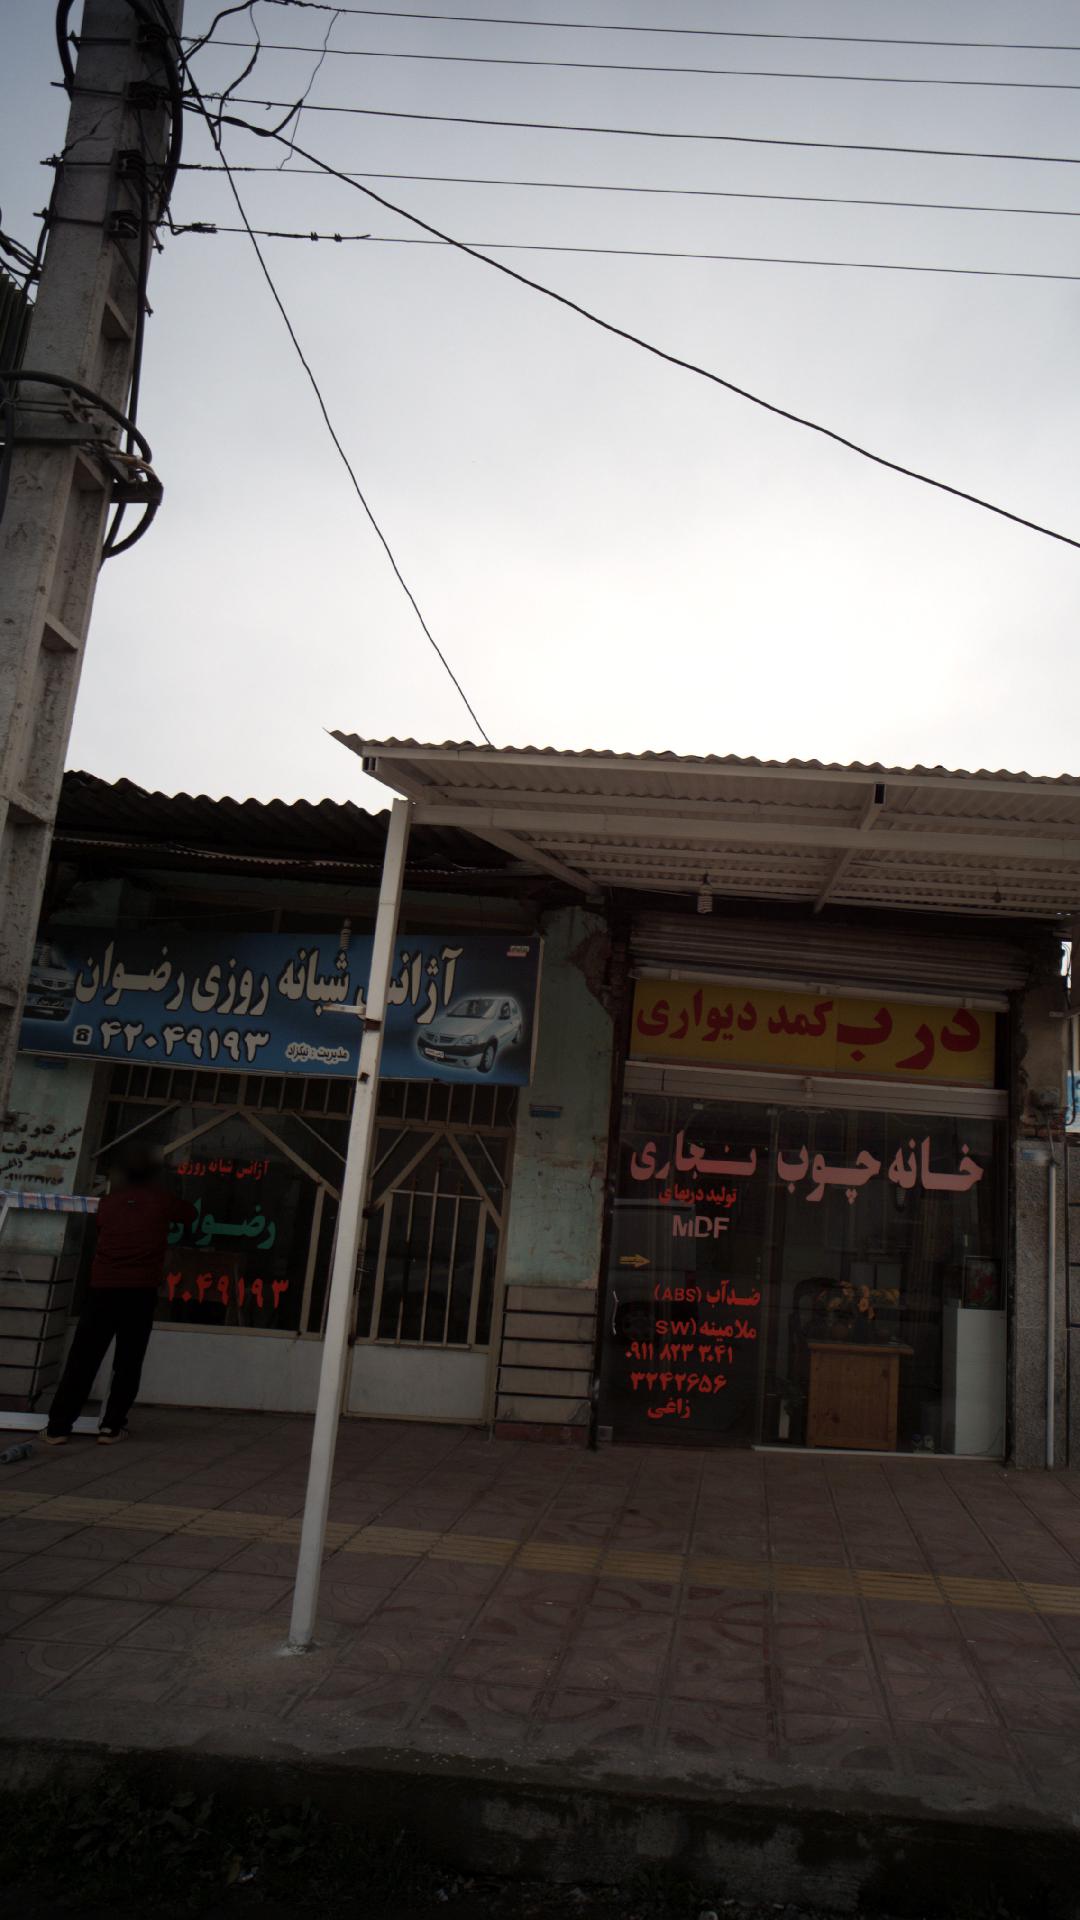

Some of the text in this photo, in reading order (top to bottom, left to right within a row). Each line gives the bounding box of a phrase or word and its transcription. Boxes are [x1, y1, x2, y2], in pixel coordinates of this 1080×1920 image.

[75, 940, 186, 1011] رضوان
[191, 958, 270, 1016] روزی
[278, 947, 350, 1016] شبانه
[99, 1020, 270, 1062] ۴۲۰۴۹۱۹۳
[636, 988, 981, 1070] درب کمد دیواری
[176, 1157, 271, 1181] آژانس شبانه روزی
[630, 1129, 985, 1204] خانه چوب نجاری
[704, 1184, 738, 1209] تولید
[167, 1197, 278, 1250] رضوان
[672, 1214, 730, 1240] MDF
[166, 1271, 291, 1311] ۲۰۴۹۱۹۳
